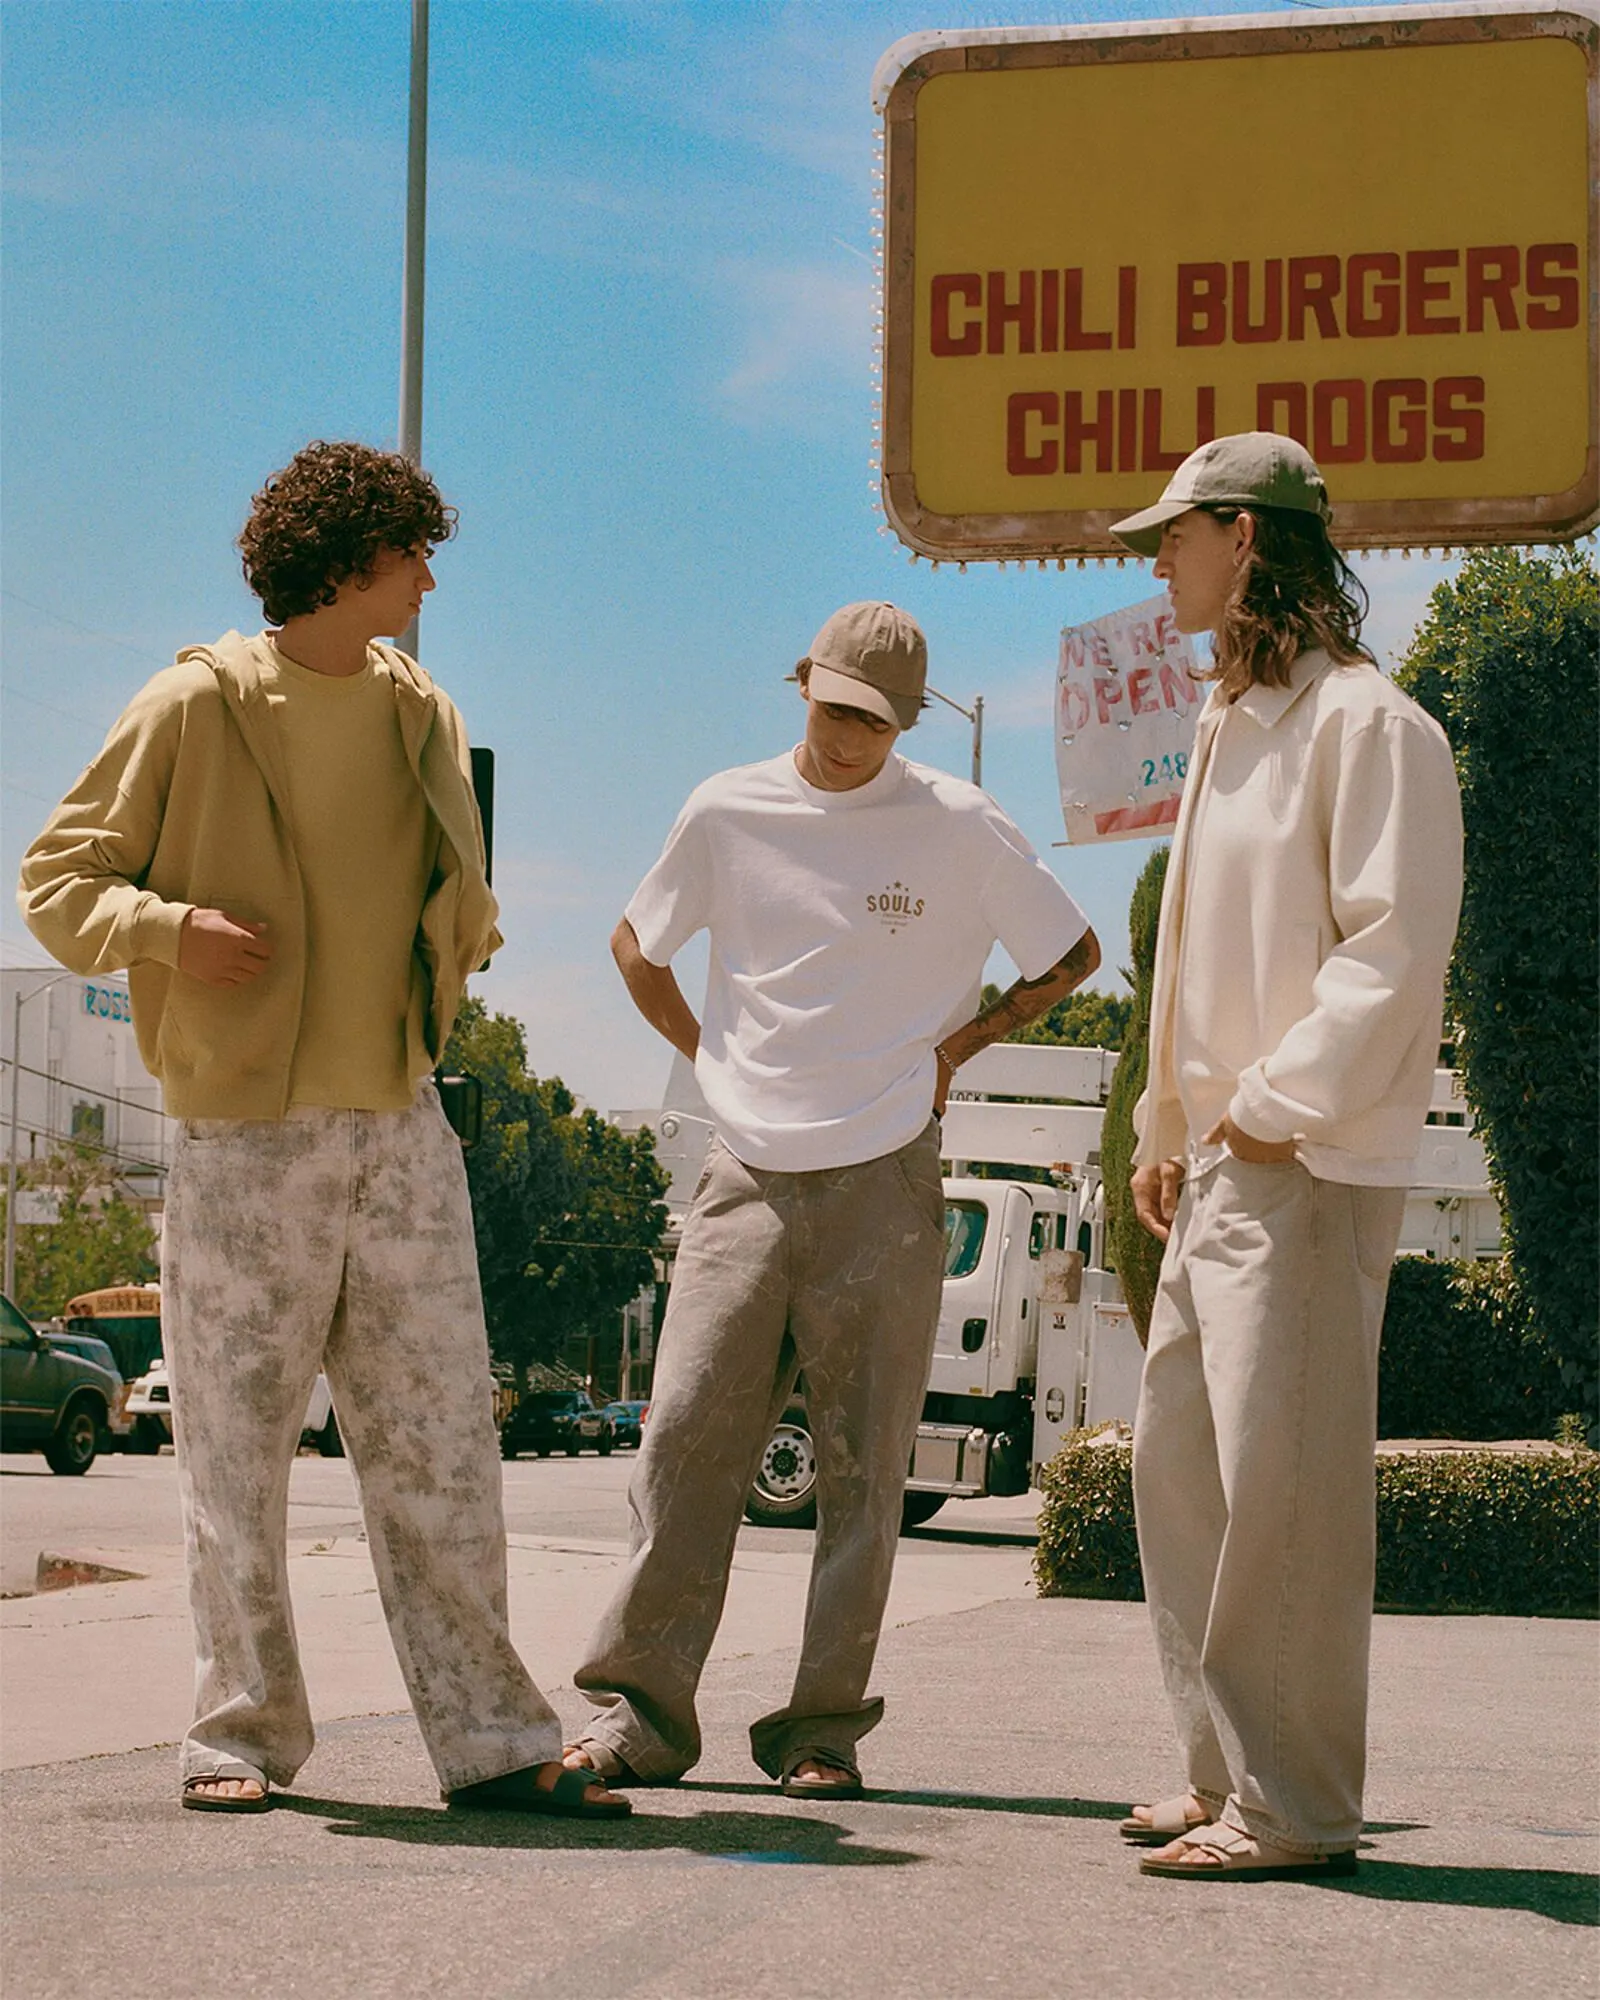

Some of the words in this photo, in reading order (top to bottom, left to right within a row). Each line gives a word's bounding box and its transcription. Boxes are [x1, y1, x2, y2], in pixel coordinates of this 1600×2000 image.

[930, 265, 1136, 357] CHILI
[1176, 242, 1580, 348] BURGERS
[1006, 386, 1216, 476] CHILI
[1256, 376, 1485, 465] DOGS
[1060, 656, 1198, 731] OPEN
[866, 893, 925, 917] SOULS
